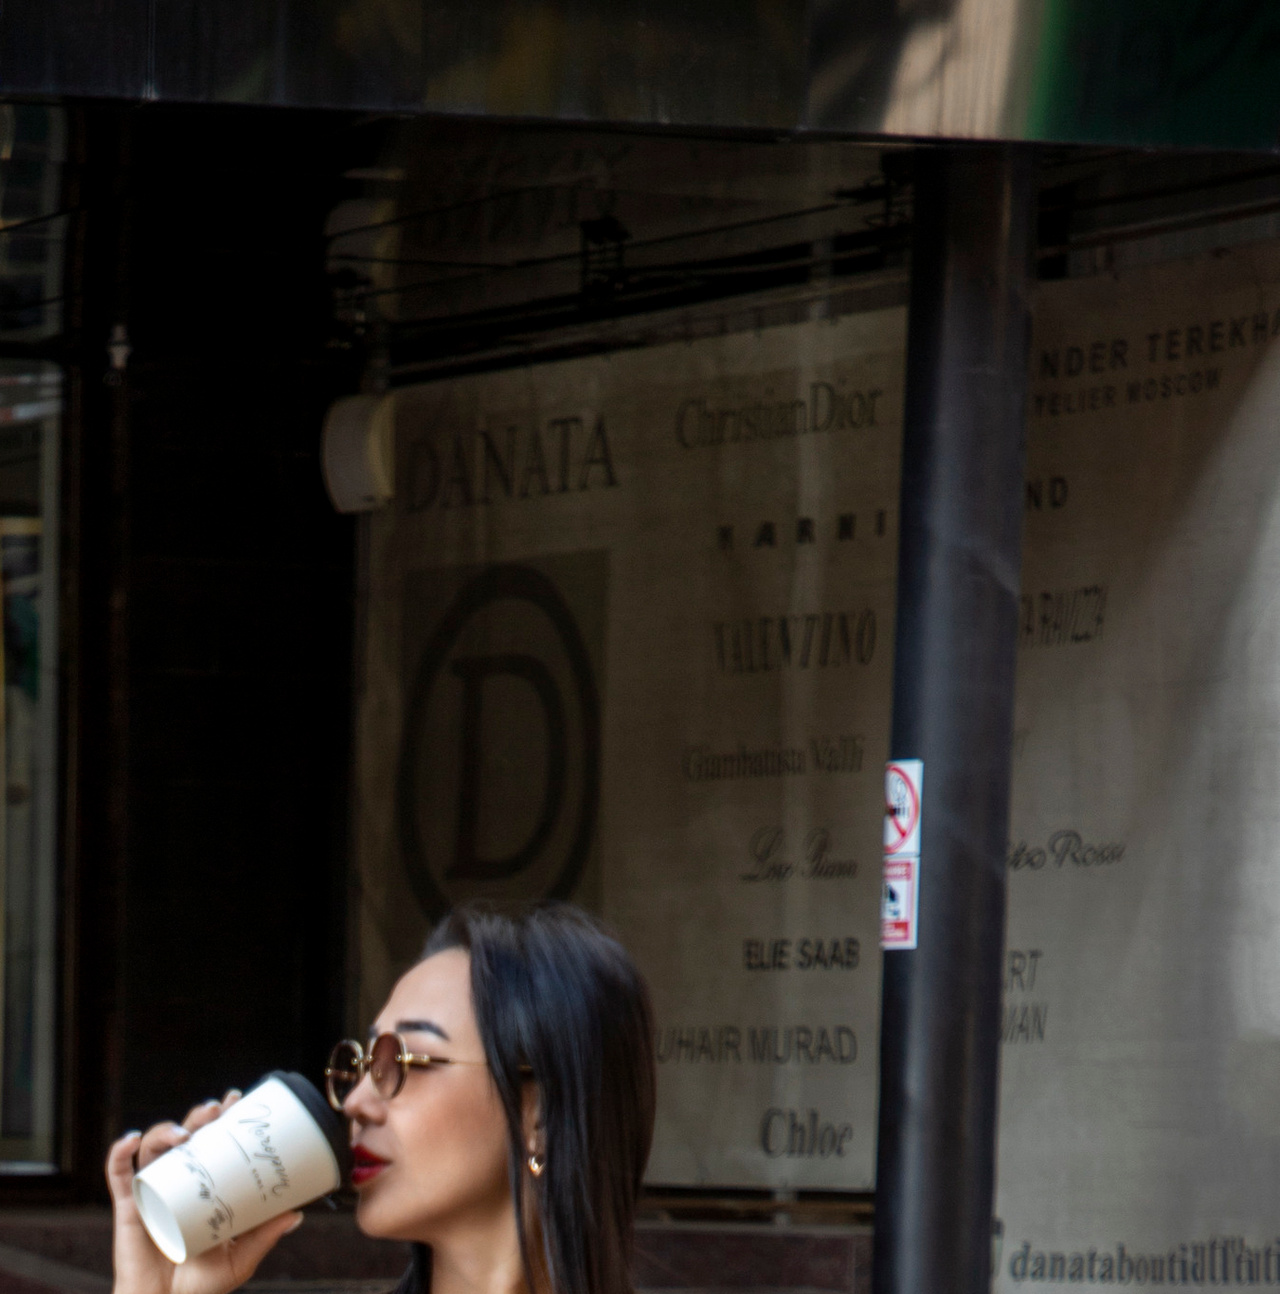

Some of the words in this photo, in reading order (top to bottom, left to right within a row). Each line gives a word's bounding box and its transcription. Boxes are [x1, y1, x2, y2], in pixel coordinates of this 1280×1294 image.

[1038, 337, 1129, 380] NDER
[1032, 384, 1117, 418] TELIER
[1125, 367, 1220, 405] MOSCOW
[404, 414, 620, 515] DANATA
[1024, 474, 1070, 512] ND
[714, 607, 878, 675] VALENTINO
[742, 937, 789, 971] ELIE
[796, 936, 861, 971] SAAB
[654, 1024, 742, 1065] UHAIR
[746, 1024, 859, 1065] MURAD
